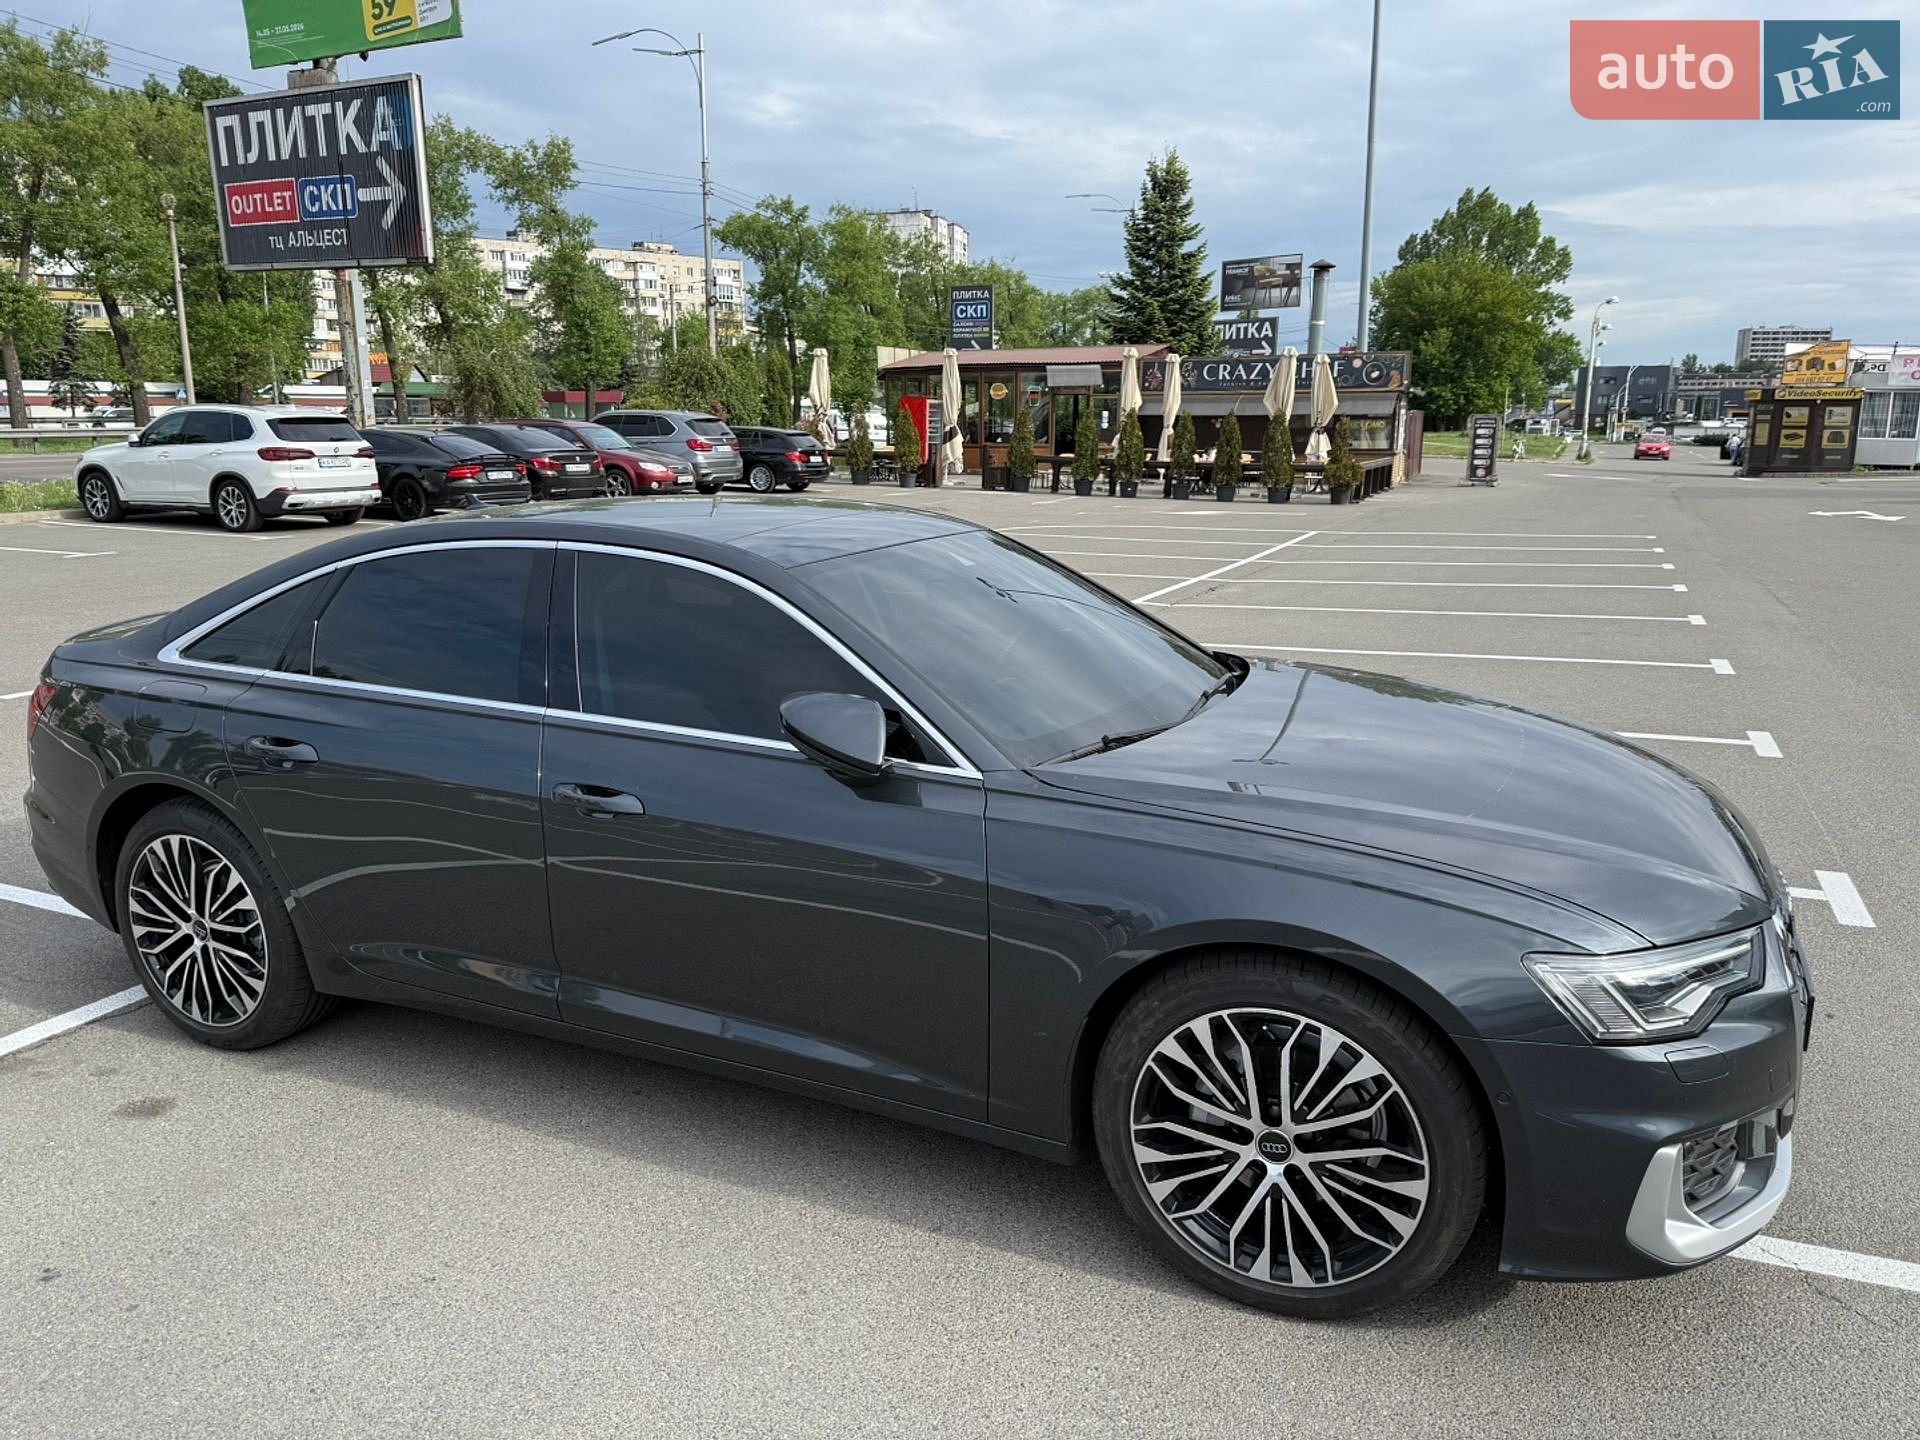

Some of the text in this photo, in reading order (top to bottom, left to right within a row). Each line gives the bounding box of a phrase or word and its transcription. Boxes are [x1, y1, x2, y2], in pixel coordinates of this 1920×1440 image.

[215, 96, 403, 167] ПЛИТКА
[230, 191, 292, 215] OUTLET
[303, 183, 352, 213] СКП
[288, 229, 349, 249] АЛЬЦЕСТ
[953, 290, 990, 299] ПЛИТКА
[956, 304, 987, 318] СКП
[1214, 321, 1273, 340] ЛИТКА
[1202, 361, 1278, 380] CRAZY
